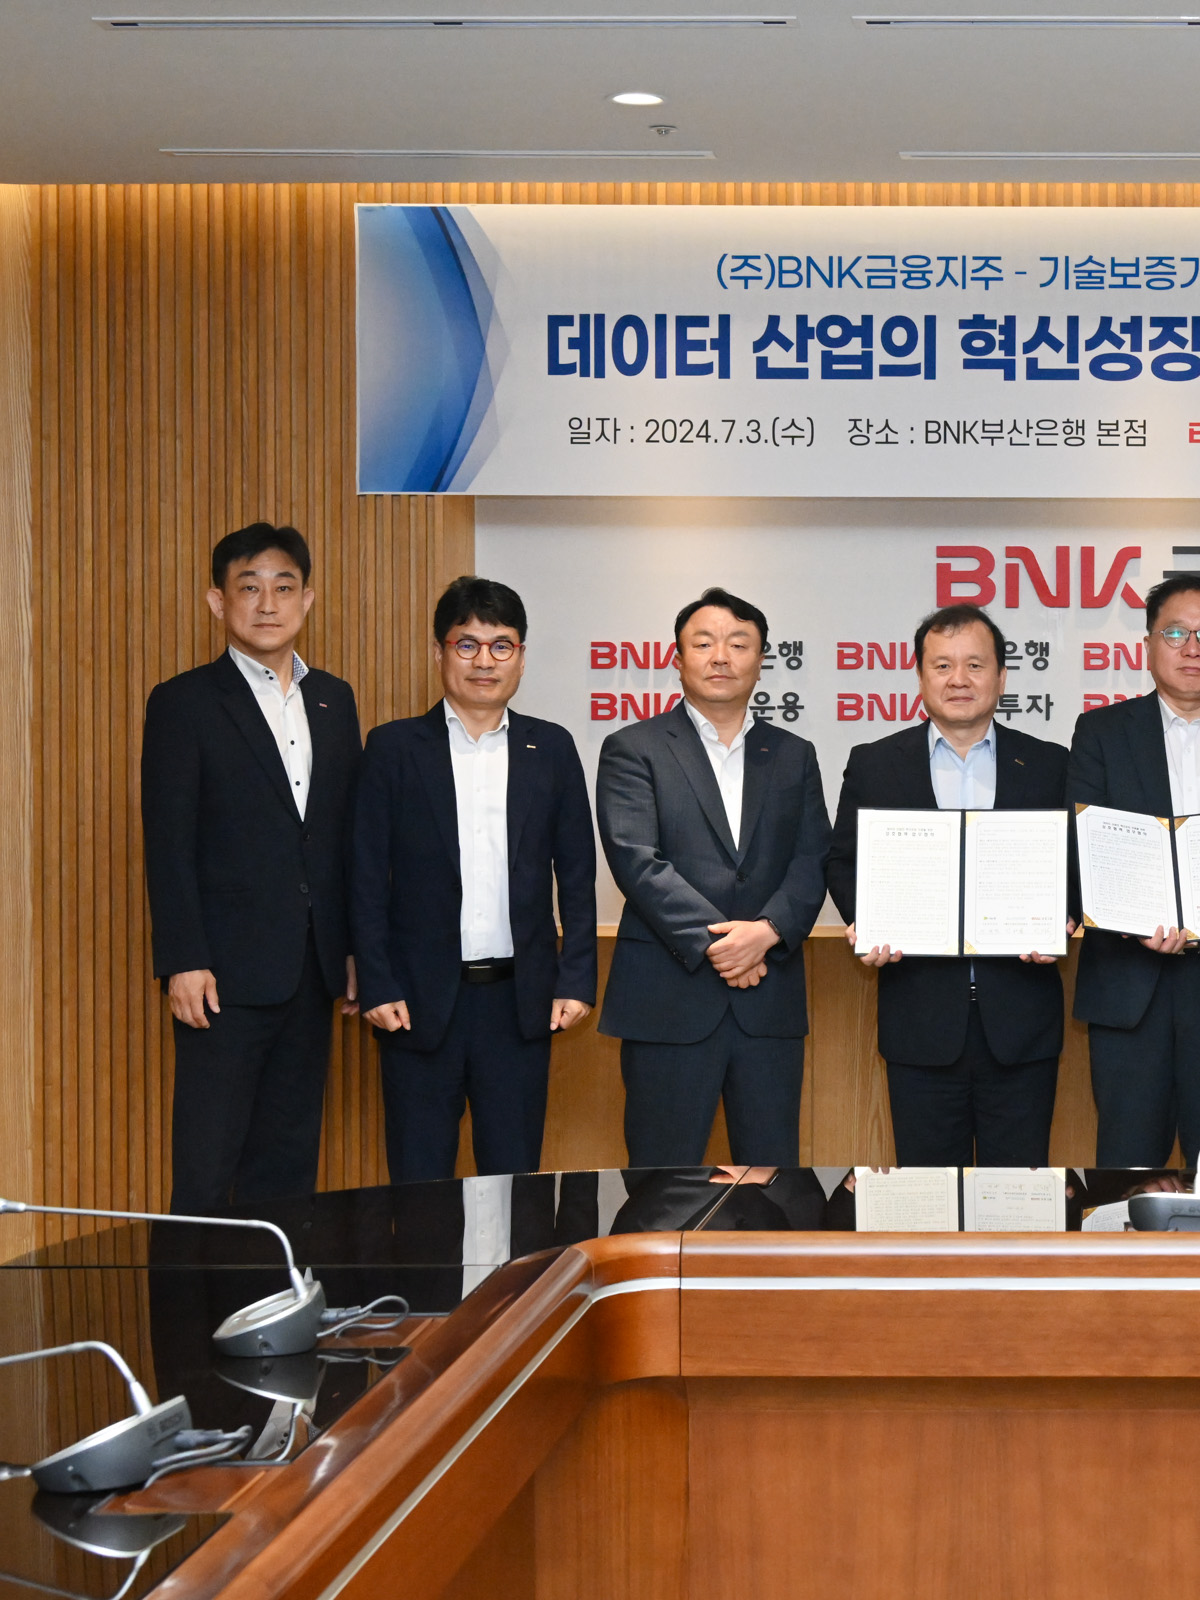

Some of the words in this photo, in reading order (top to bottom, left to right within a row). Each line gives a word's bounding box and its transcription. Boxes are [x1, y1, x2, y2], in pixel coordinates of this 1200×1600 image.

[717, 254, 1004, 291] (주)BNK금융지주
[547, 313, 731, 380] 데이터
[752, 314, 937, 380] 산업의
[567, 417, 622, 445] 일자
[644, 416, 815, 447] 2024.7.3.(수)
[847, 418, 900, 446] 장소
[924, 418, 1086, 447] BNK부산은행
[1095, 420, 1147, 447] 본점
[936, 546, 1146, 609] BNK
[1083, 643, 1150, 671] BN
[837, 693, 929, 721] BNK
